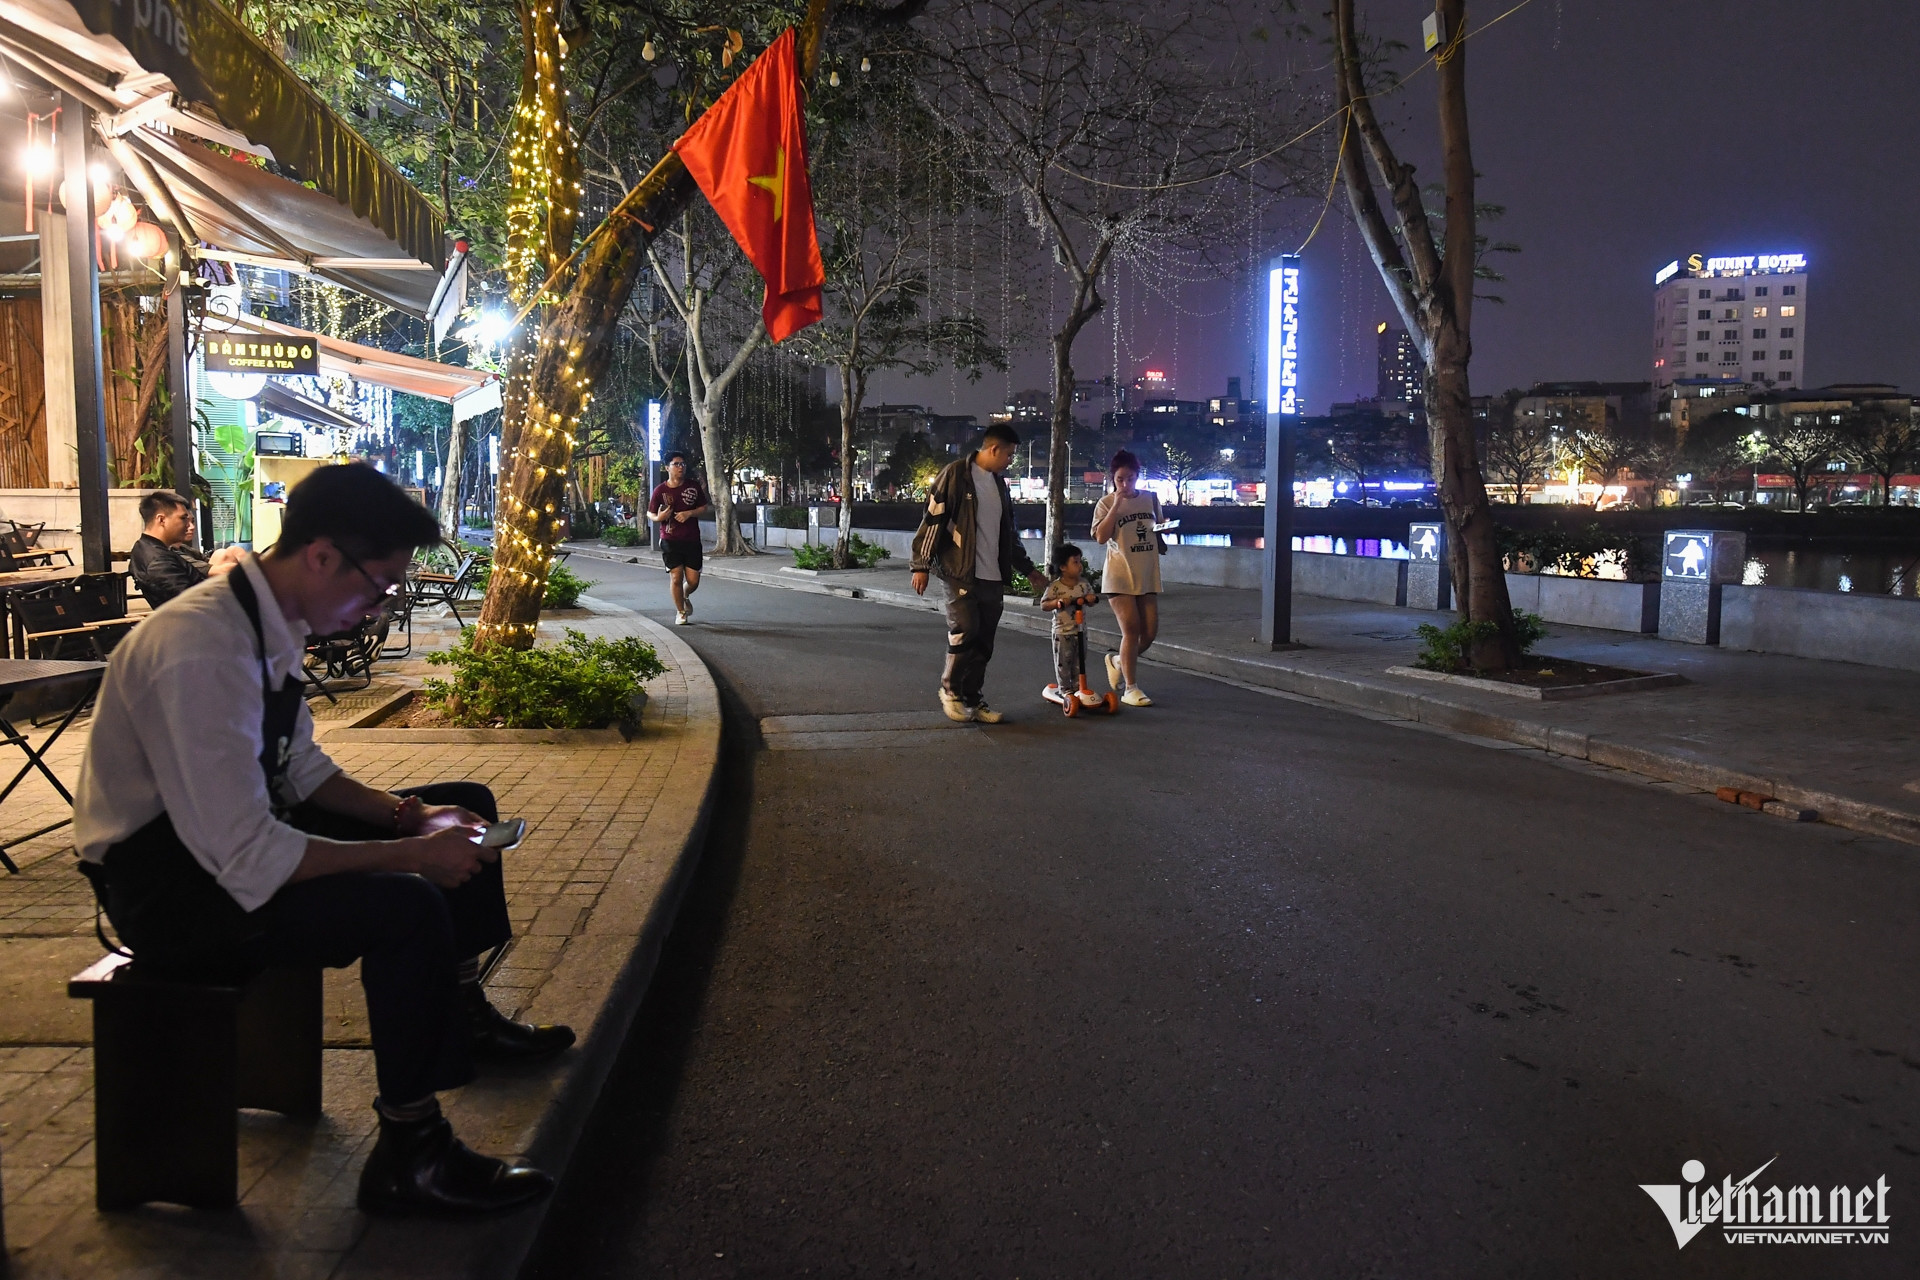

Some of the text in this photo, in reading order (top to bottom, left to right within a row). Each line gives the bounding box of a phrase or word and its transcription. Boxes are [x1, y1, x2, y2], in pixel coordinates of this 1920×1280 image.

[1707, 255, 1755, 271] SUNNY
[1757, 253, 1807, 269] HOTEL
[228, 357, 295, 369] COFFEE & TEA
